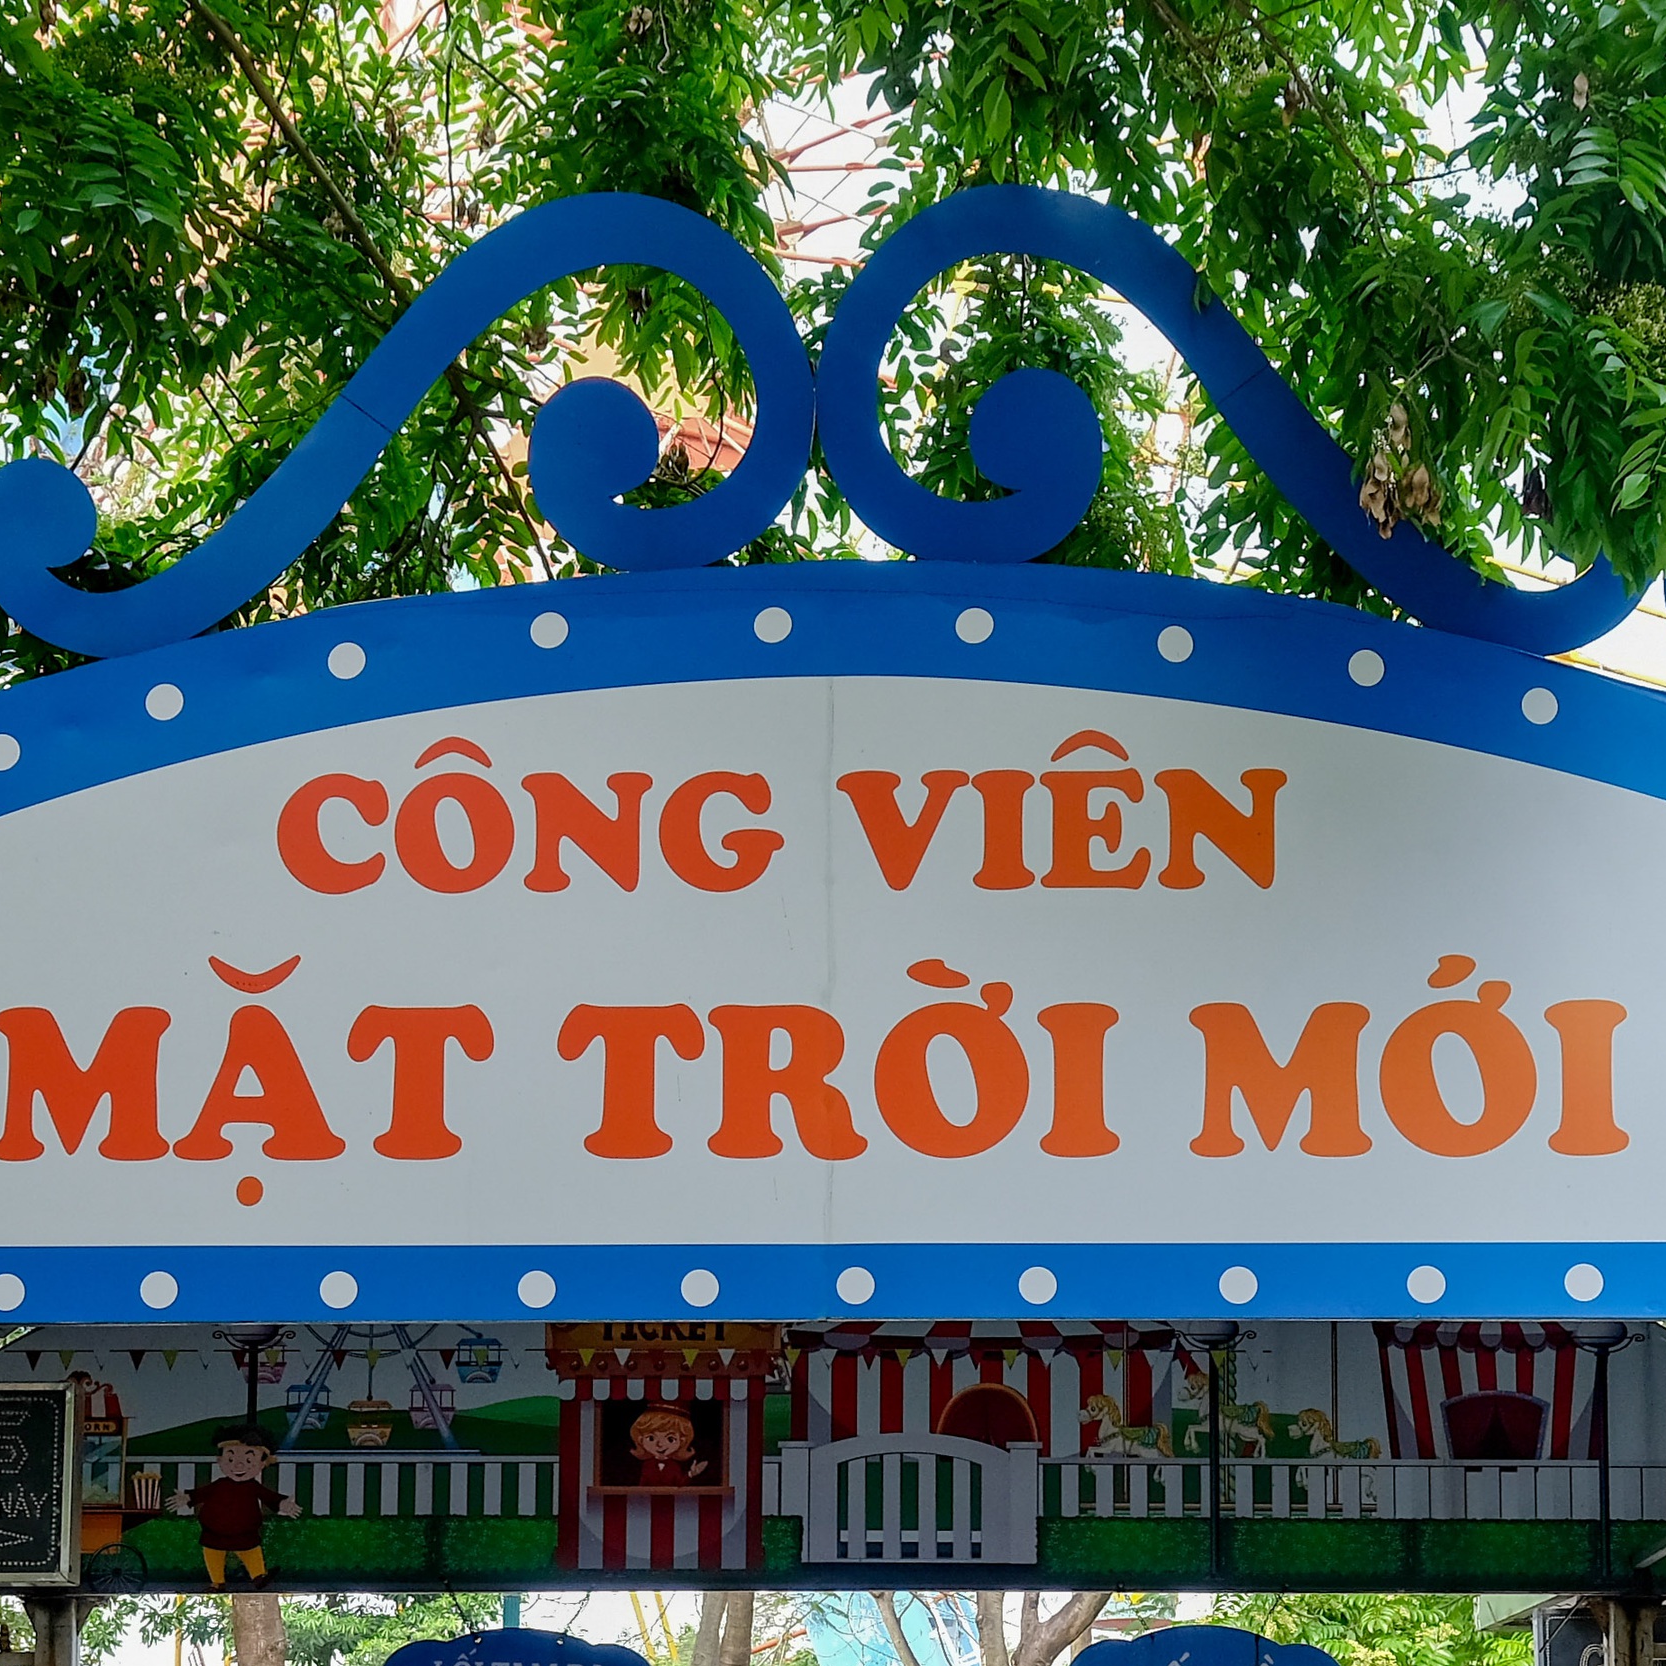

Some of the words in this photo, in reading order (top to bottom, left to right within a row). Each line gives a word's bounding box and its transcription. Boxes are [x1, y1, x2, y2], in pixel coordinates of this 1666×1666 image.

[278, 737, 783, 894] CÔNG
[837, 731, 1286, 890] VIÊN
[558, 960, 1119, 1161] TRỜI
[1190, 955, 1629, 1158] MỚI
